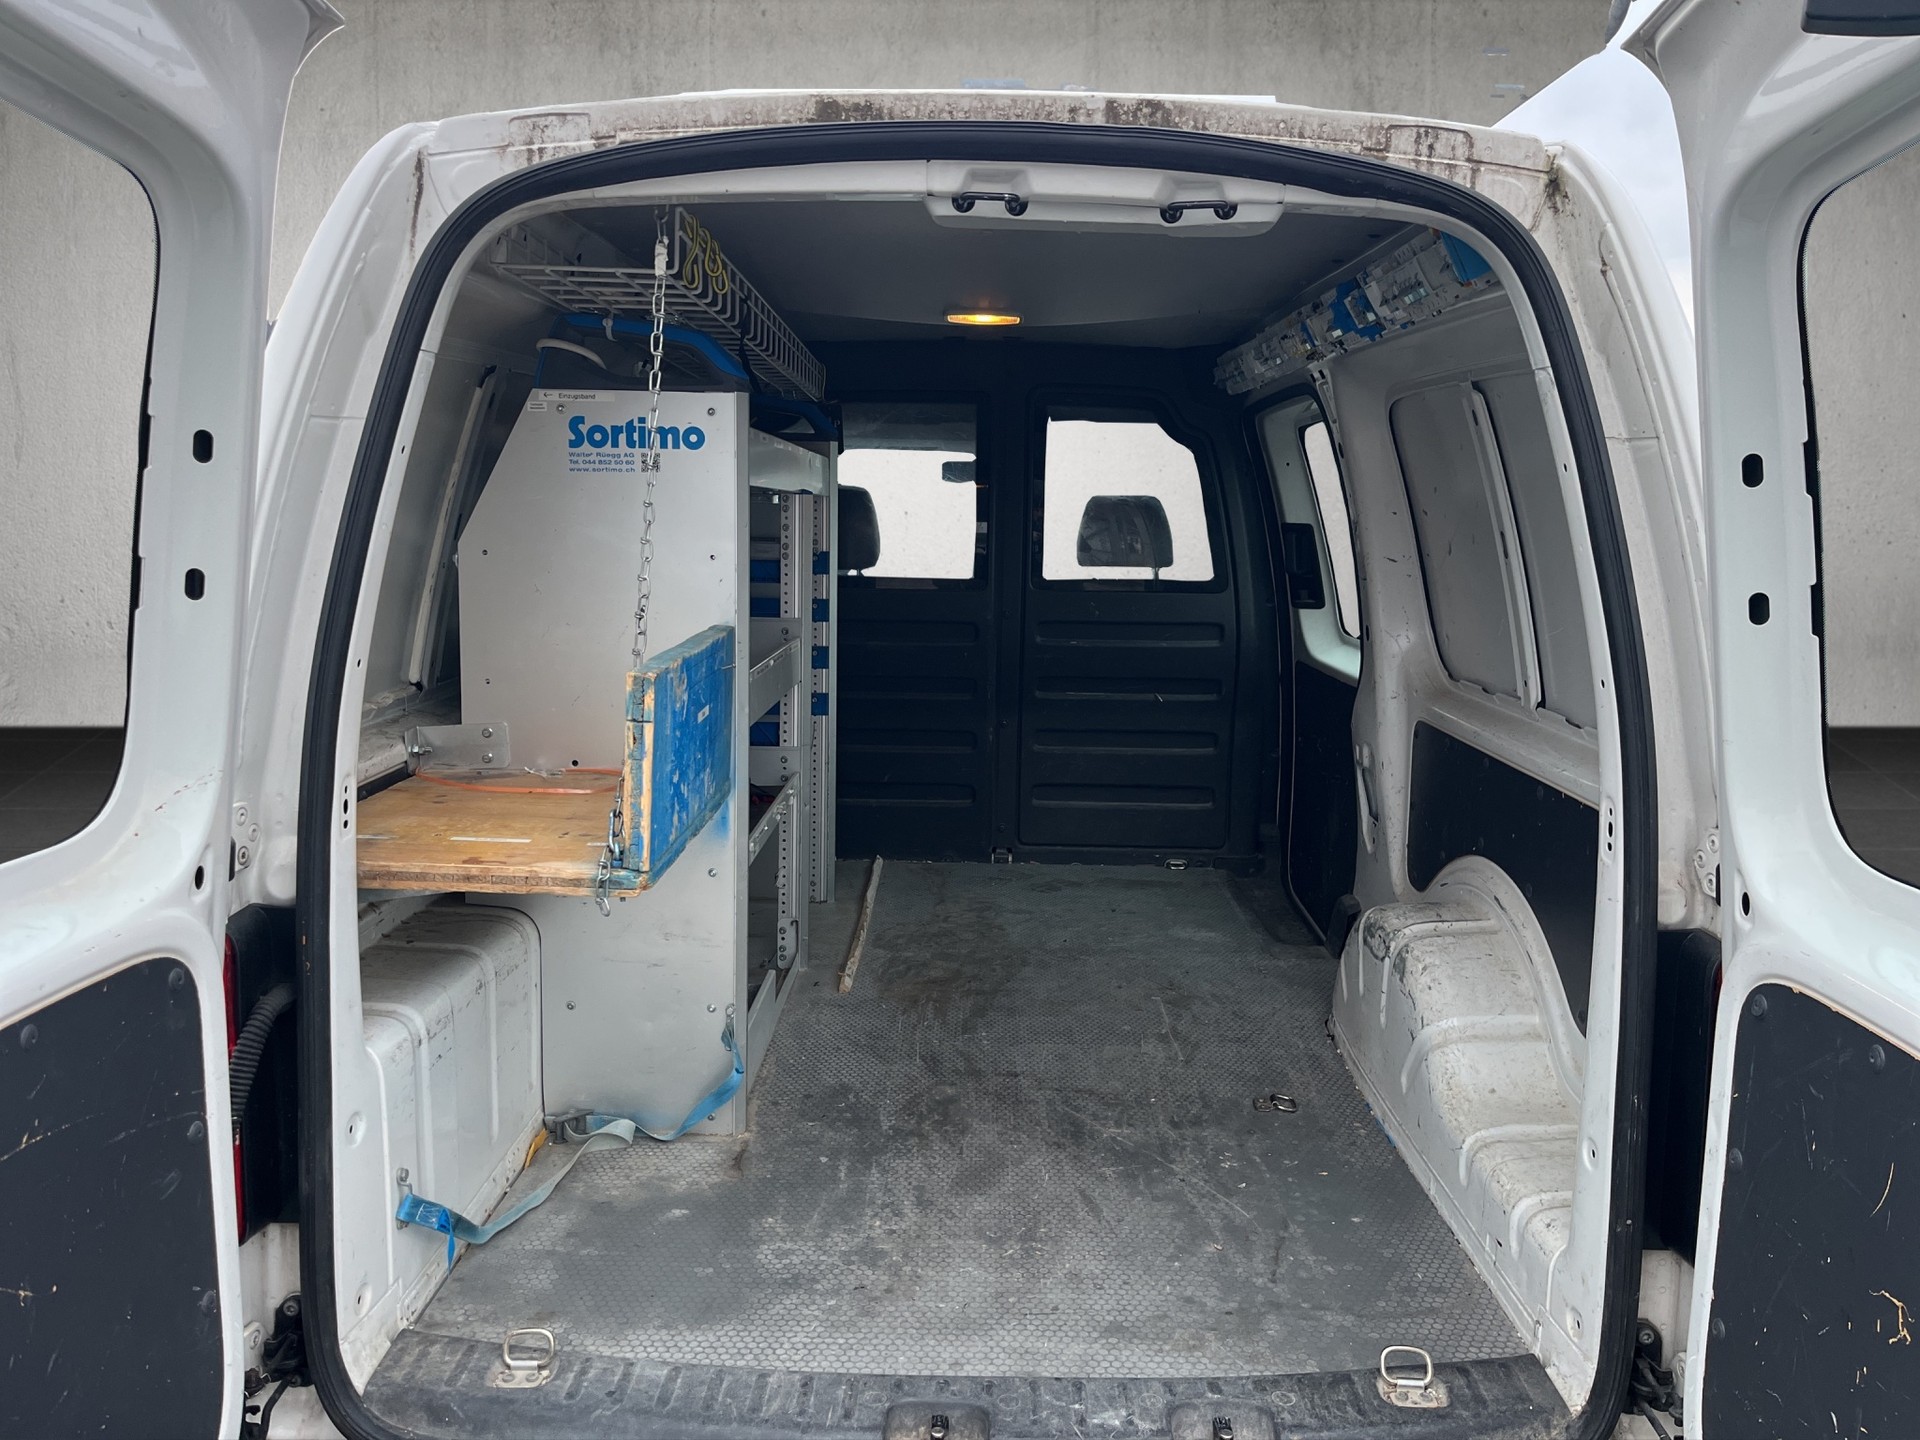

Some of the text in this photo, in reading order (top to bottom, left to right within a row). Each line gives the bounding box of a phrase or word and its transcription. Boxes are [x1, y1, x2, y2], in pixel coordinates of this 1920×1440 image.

[558, 392, 596, 400] Einzugsband
[568, 416, 705, 450] Sortimo
[595, 451, 621, 459] Rüegg
